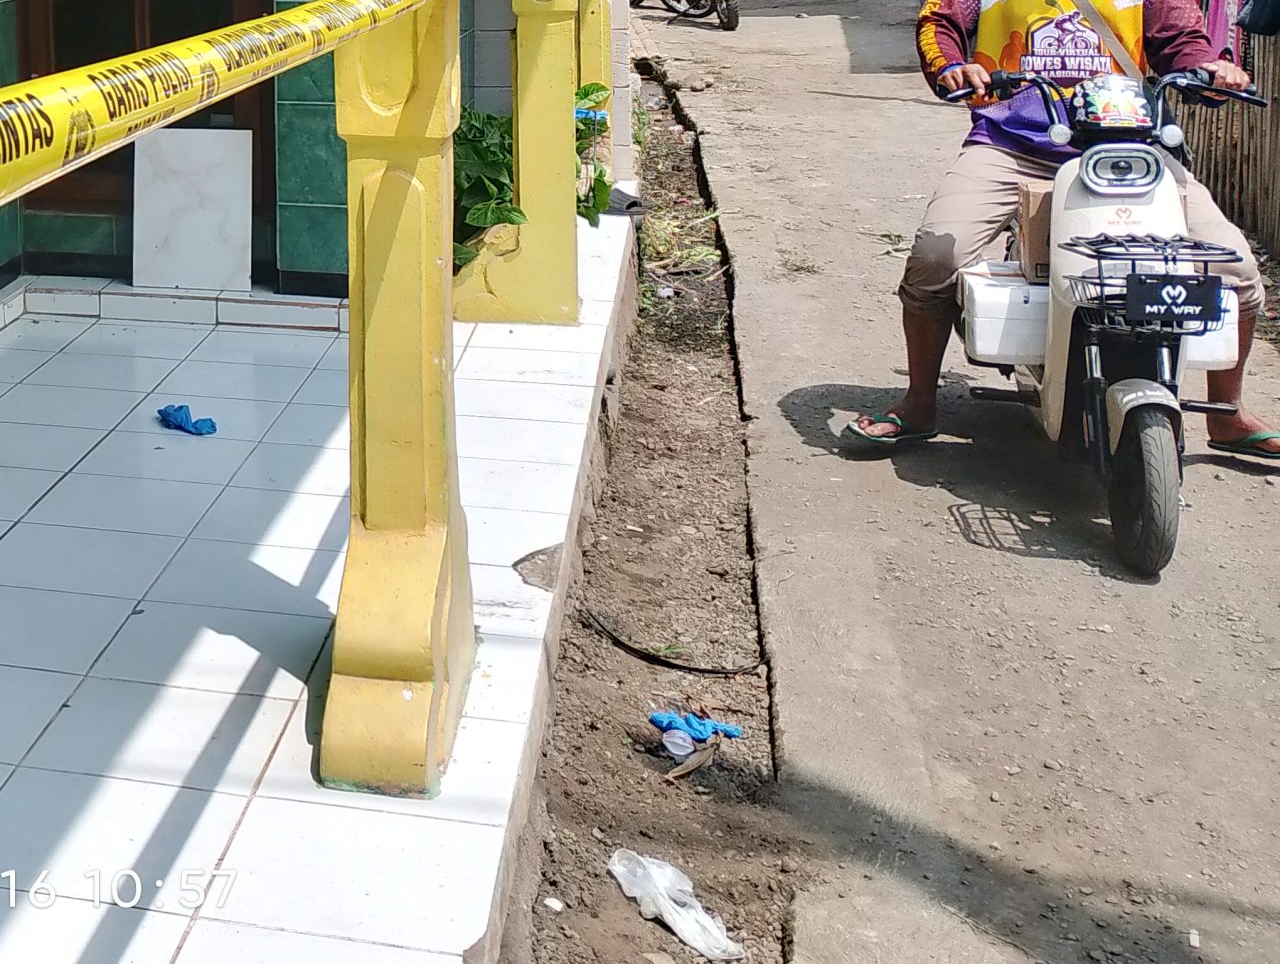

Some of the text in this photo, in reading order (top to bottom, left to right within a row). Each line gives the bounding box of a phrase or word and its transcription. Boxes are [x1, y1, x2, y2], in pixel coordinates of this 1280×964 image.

[1060, 47, 1100, 56] VIRTUAL
[1065, 56, 1112, 74] WISATA
[1145, 304, 1204, 316] MY WAY
